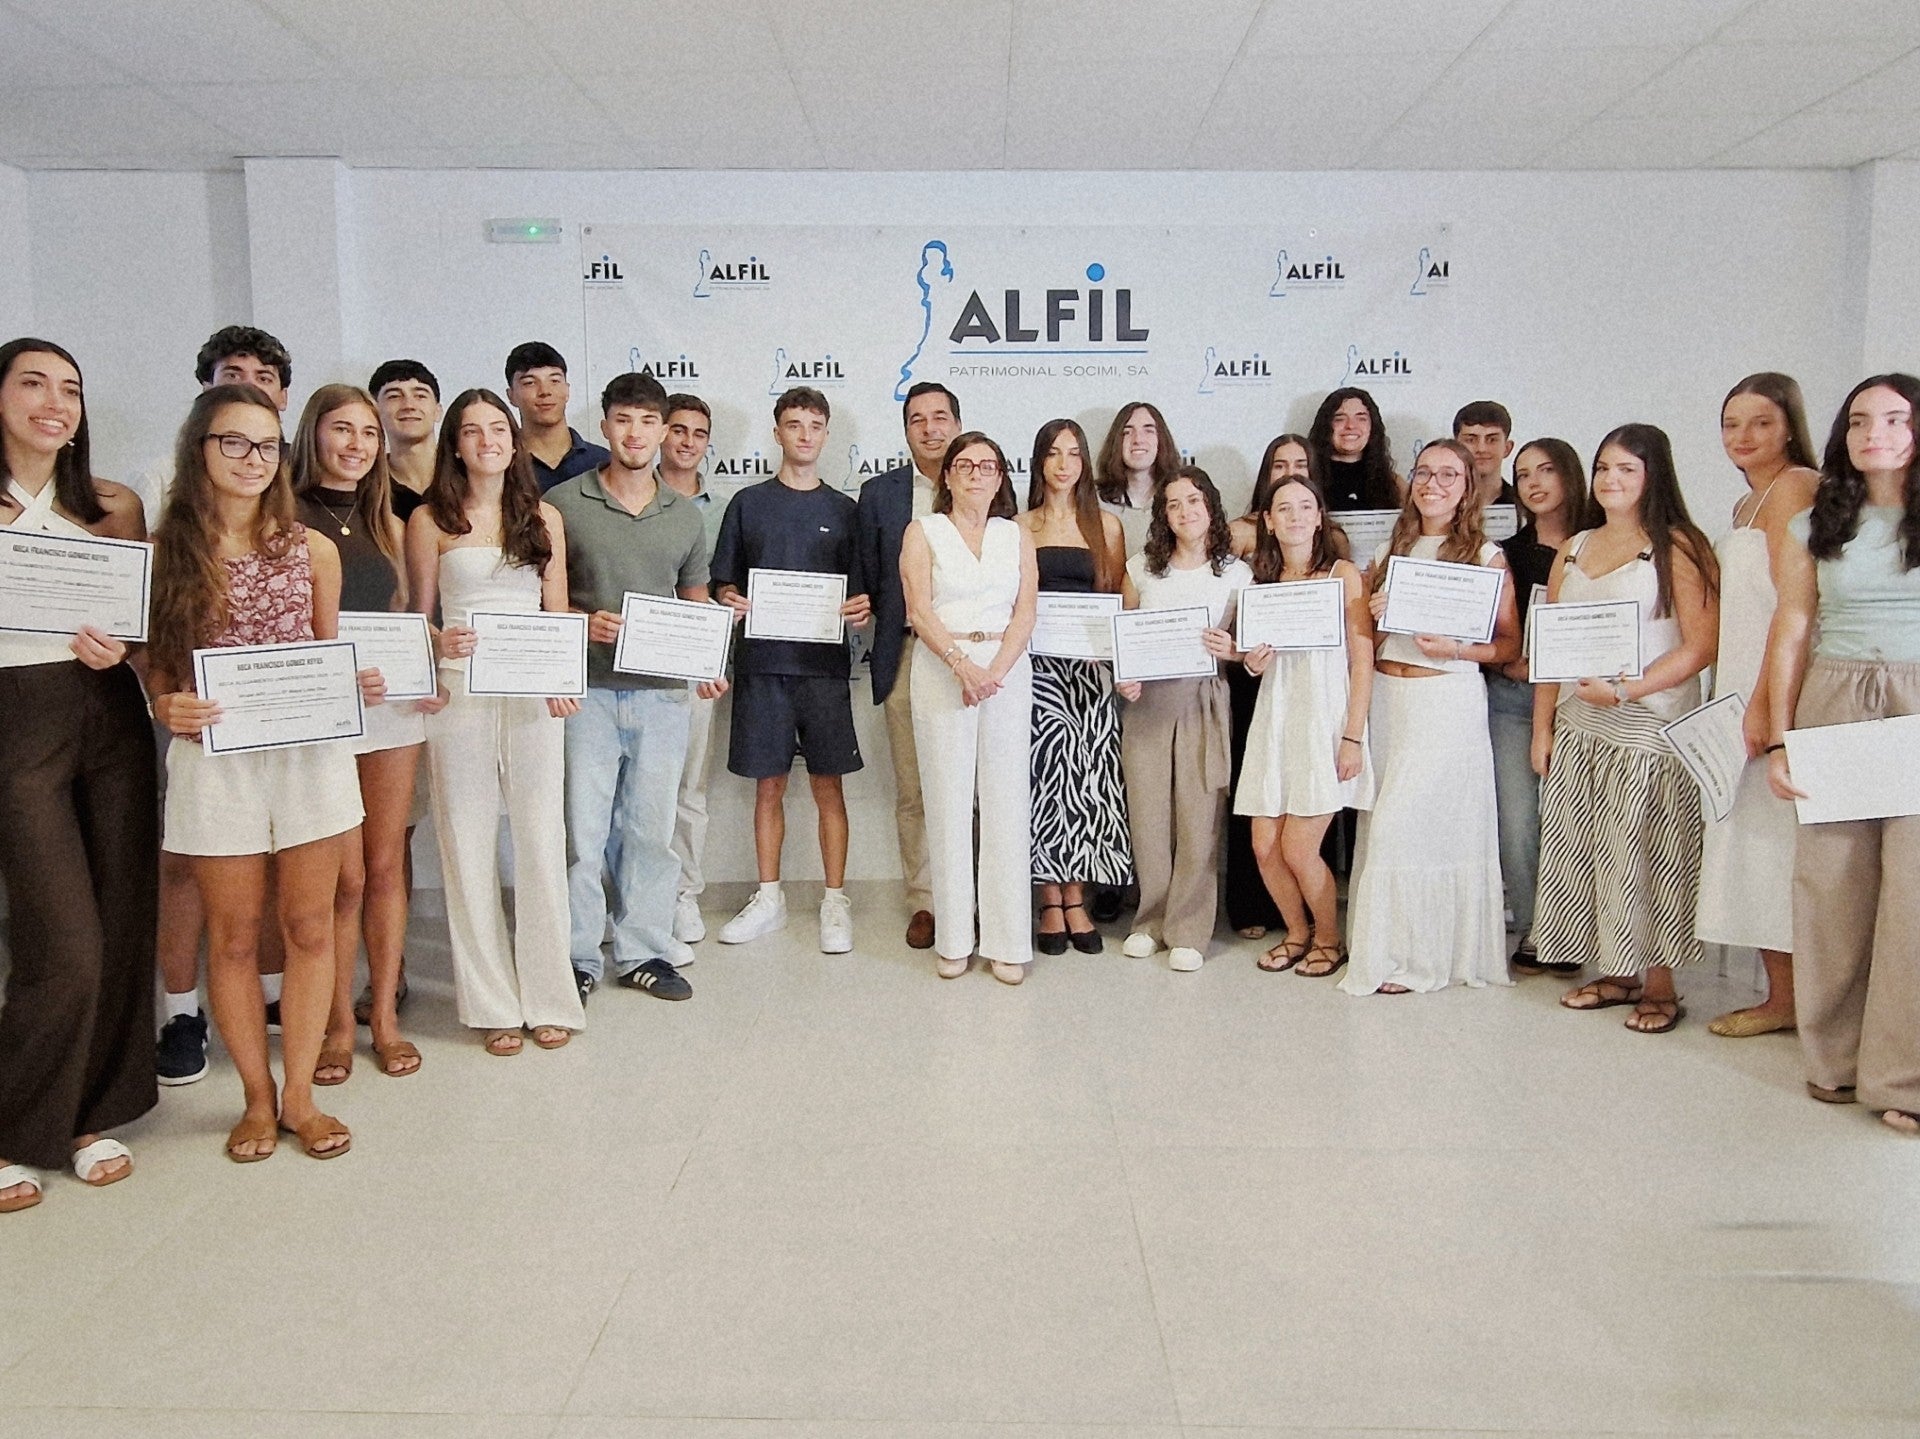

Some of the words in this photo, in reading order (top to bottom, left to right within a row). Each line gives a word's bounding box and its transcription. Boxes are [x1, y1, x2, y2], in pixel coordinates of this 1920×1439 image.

[710, 256, 770, 280] ALFIL
[1286, 256, 1345, 279] ALFIL
[949, 263, 1150, 344] ALFIL
[642, 354, 699, 377] ALFIL
[785, 354, 845, 378] ALFIL
[950, 366, 1057, 377] PATRIMONIAL
[1063, 366, 1122, 378] SOCIMI,
[1127, 366, 1149, 376] SA
[1214, 353, 1271, 376] ALFIL
[1355, 351, 1412, 374] ALFIL
[714, 451, 773, 474] ALFIL
